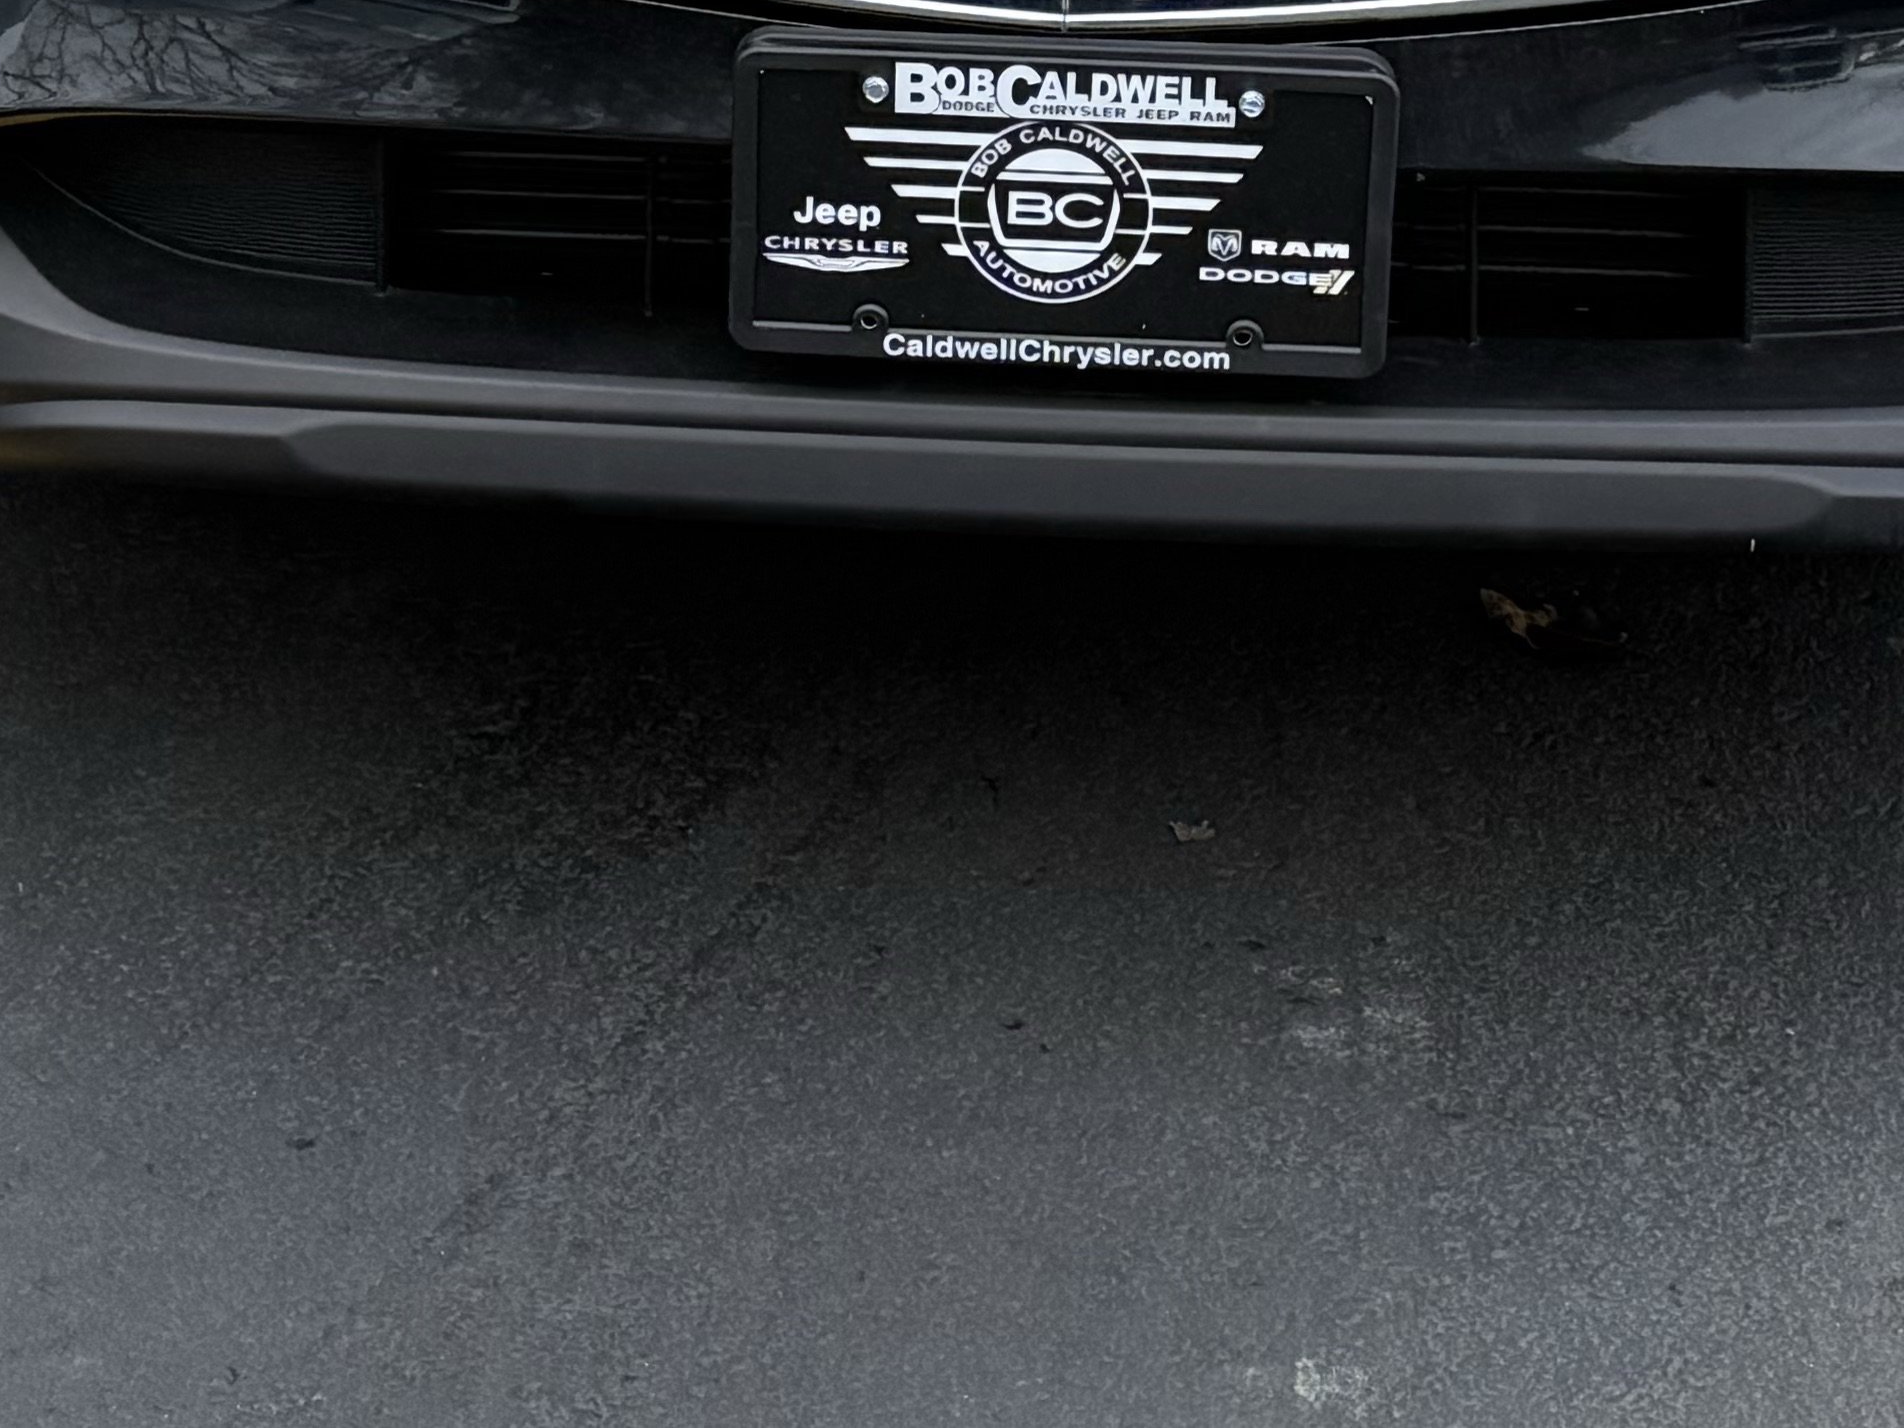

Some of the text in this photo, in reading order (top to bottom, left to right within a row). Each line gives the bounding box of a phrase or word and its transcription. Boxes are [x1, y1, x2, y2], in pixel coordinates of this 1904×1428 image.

[895, 62, 1231, 118] BOB CALDWELL
[942, 100, 1231, 124] DODGE CHRYSLER JEEP RAM
[971, 126, 1136, 186] BOB CALDWELL
[793, 196, 881, 231] Jeep
[1007, 190, 1104, 228] BC
[764, 235, 908, 254] CHRYSLER
[1251, 239, 1350, 259] RAM
[973, 240, 1127, 294] AUTOMOTIVE
[1199, 267, 1333, 287] DODGE
[883, 333, 1230, 370] CaldwellChrysler.com
